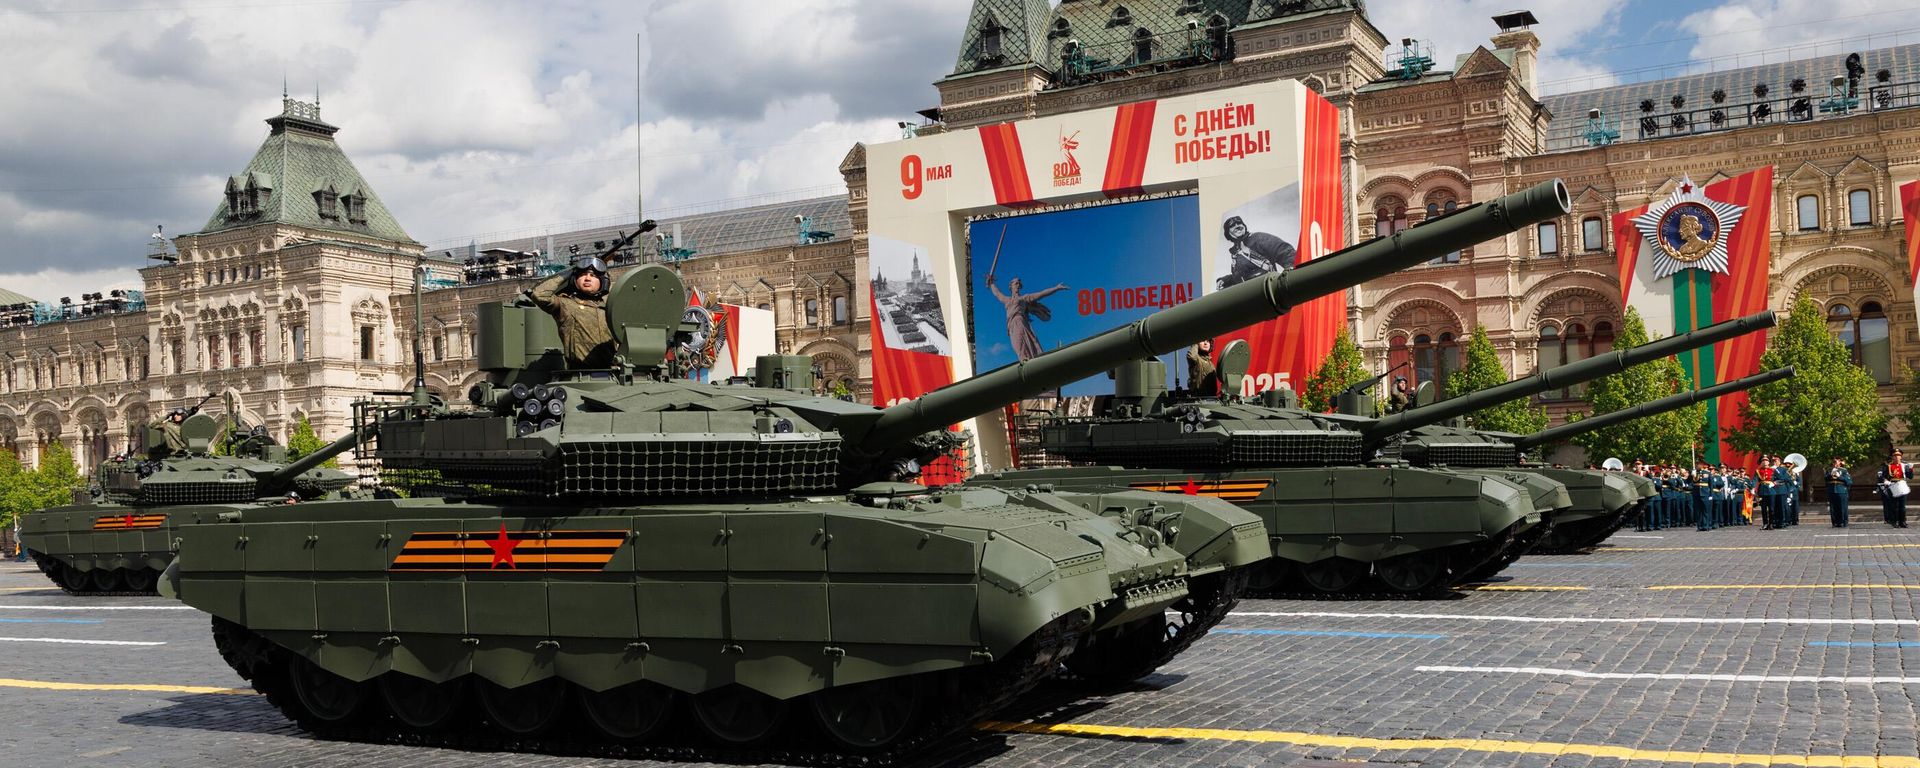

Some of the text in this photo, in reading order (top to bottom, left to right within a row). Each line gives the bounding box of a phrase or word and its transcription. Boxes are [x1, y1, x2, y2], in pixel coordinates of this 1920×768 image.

[1174, 103, 1254, 137] С ДНЁМ
[1175, 130, 1270, 164] ПОБЕДЫ!
[901, 155, 952, 199] 9 МАЯ
[1053, 162, 1068, 177] 80
[1053, 177, 1081, 187] ПОБЕДА!
[1078, 283, 1193, 315] 80 ПОБЕДА!
[1240, 372, 1291, 397] 025
